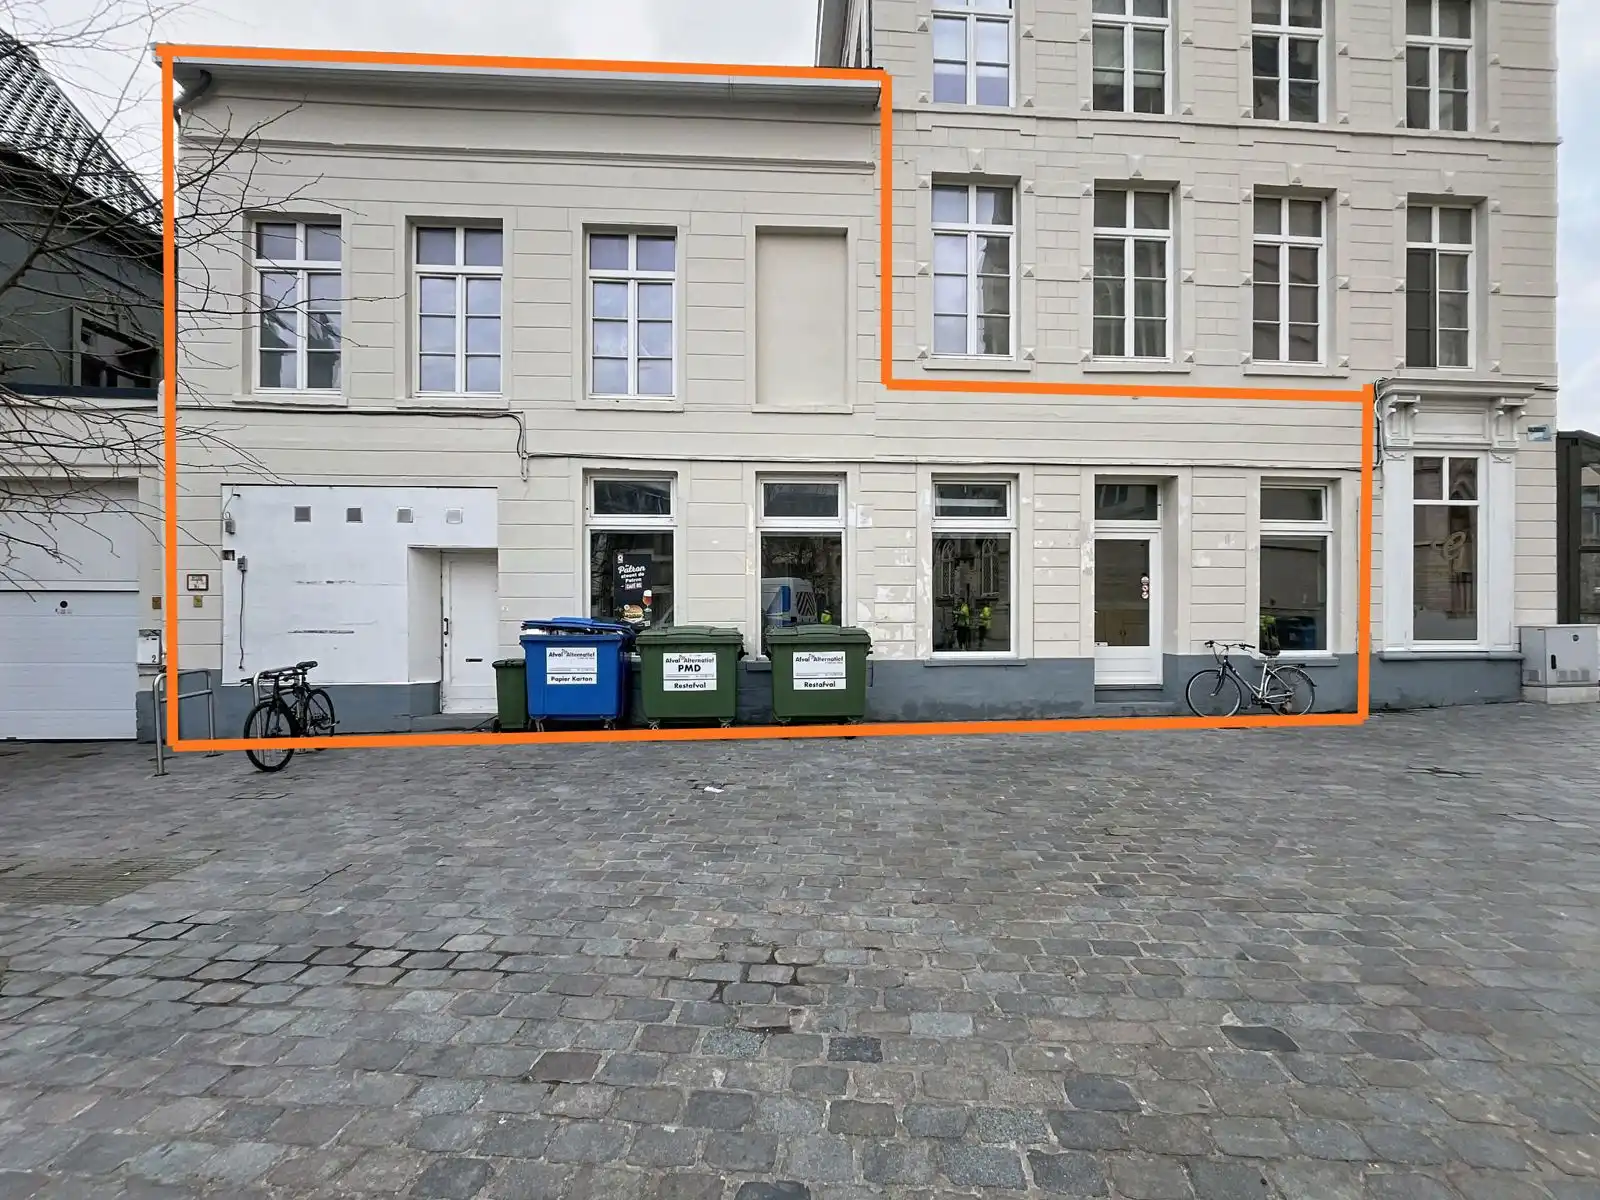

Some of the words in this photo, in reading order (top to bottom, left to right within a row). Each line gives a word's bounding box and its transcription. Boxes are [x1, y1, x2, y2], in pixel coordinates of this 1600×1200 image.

[618, 565, 645, 574] Patron
[152, 654, 157, 663] 2
[678, 664, 702, 672] PMD
